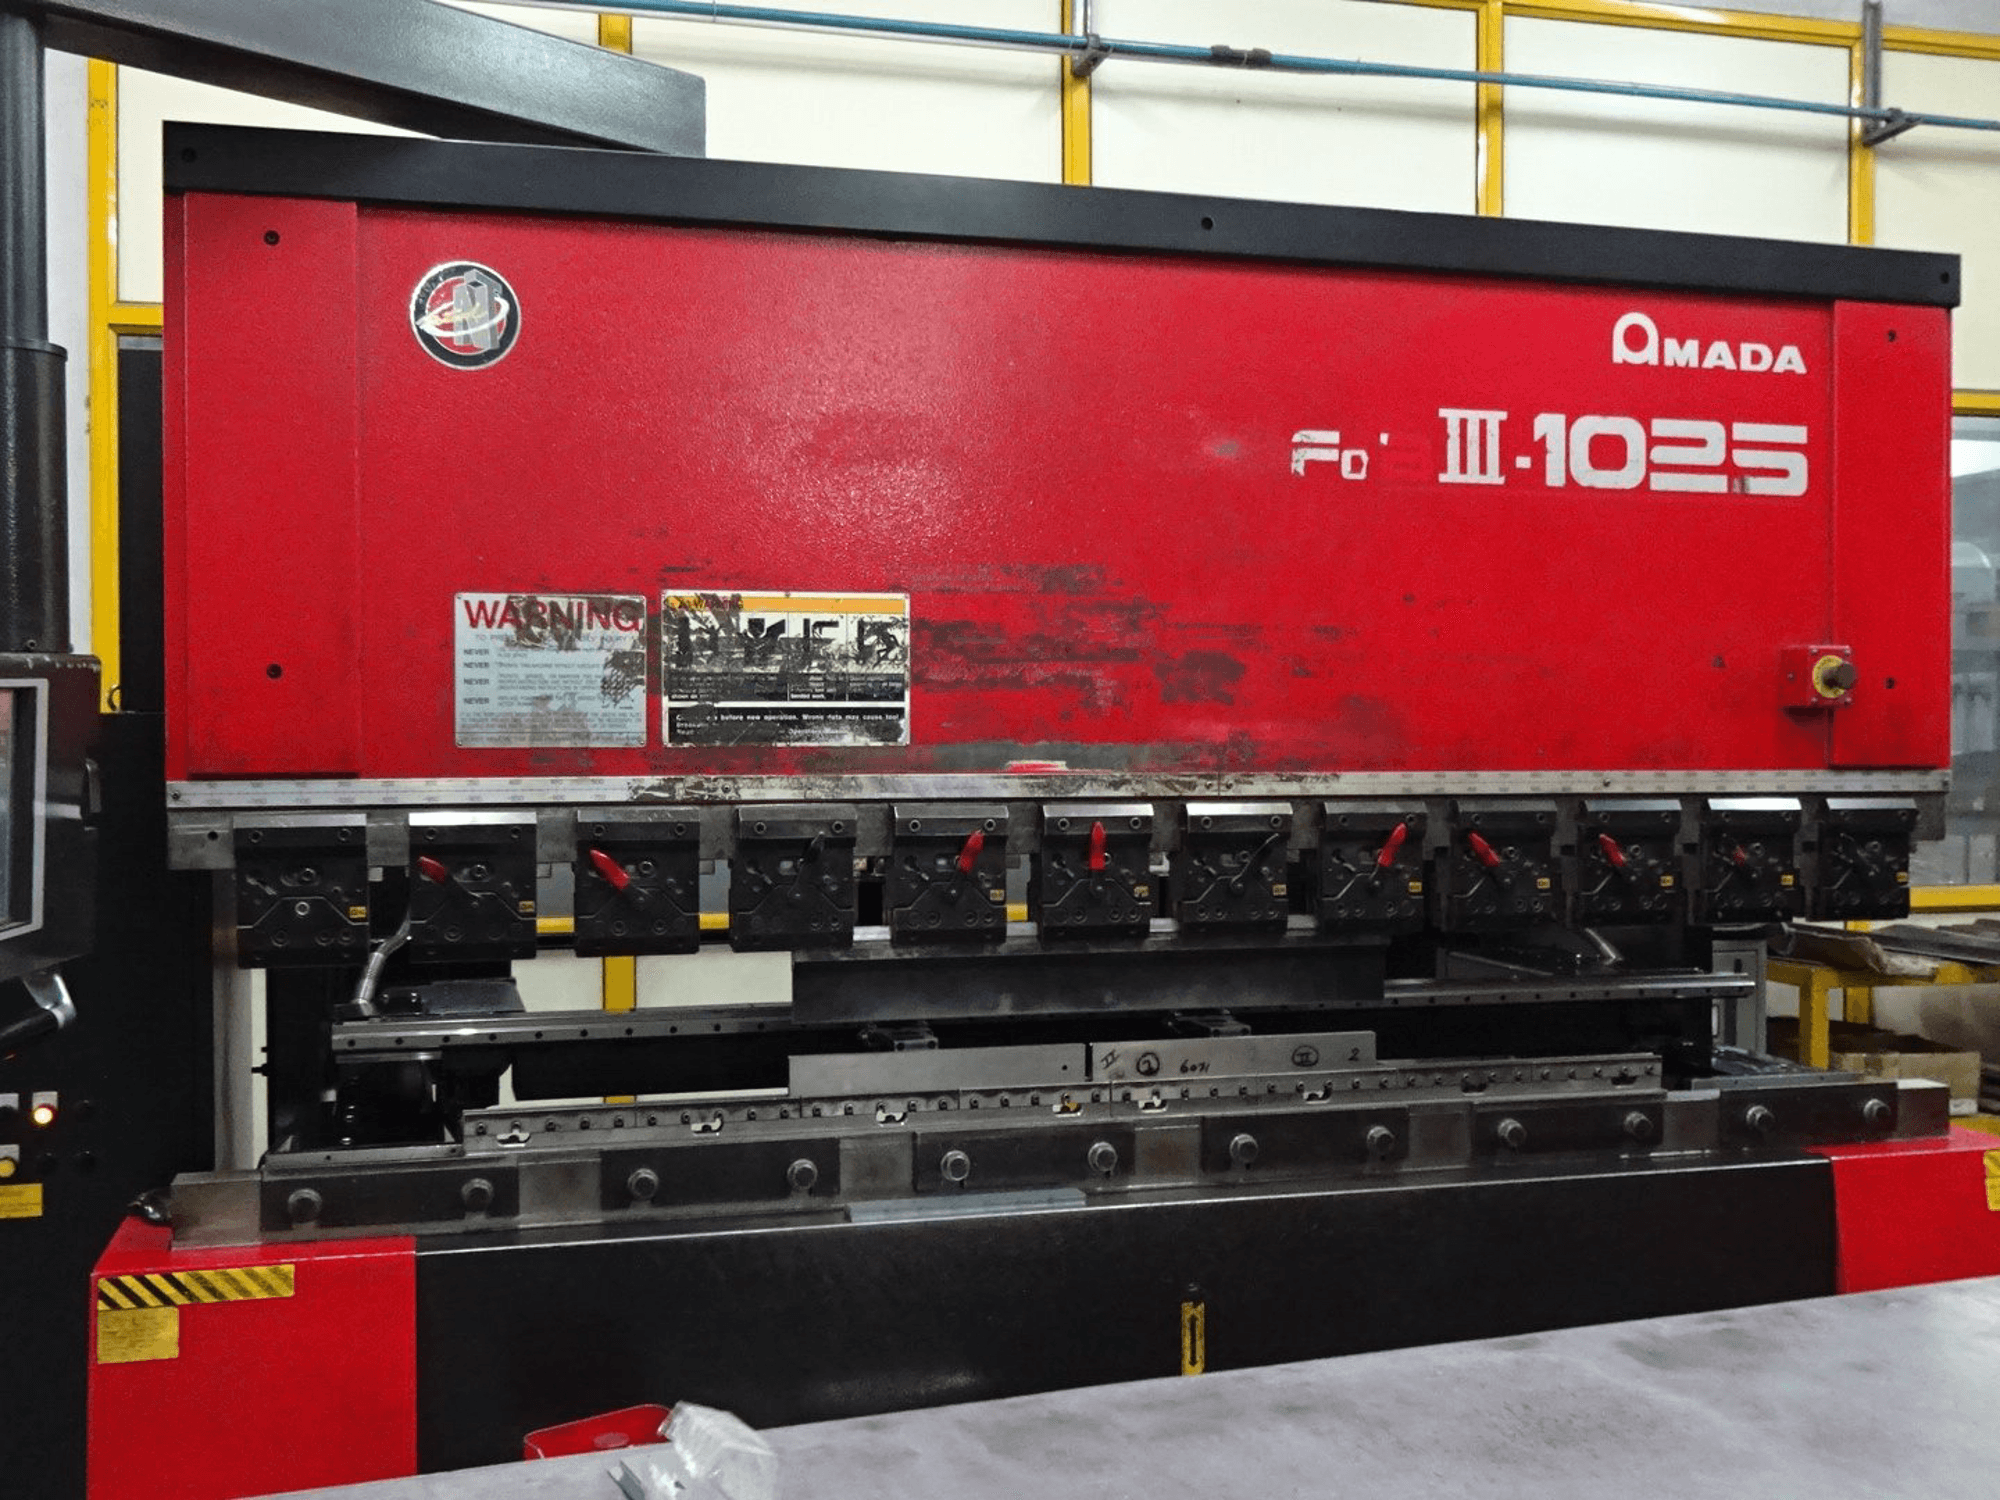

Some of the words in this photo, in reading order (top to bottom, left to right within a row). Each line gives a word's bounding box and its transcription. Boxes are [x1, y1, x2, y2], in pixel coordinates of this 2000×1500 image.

[464, 600, 640, 632] WARNING
[463, 678, 490, 686] NEVER
[463, 697, 490, 705] NEVER
